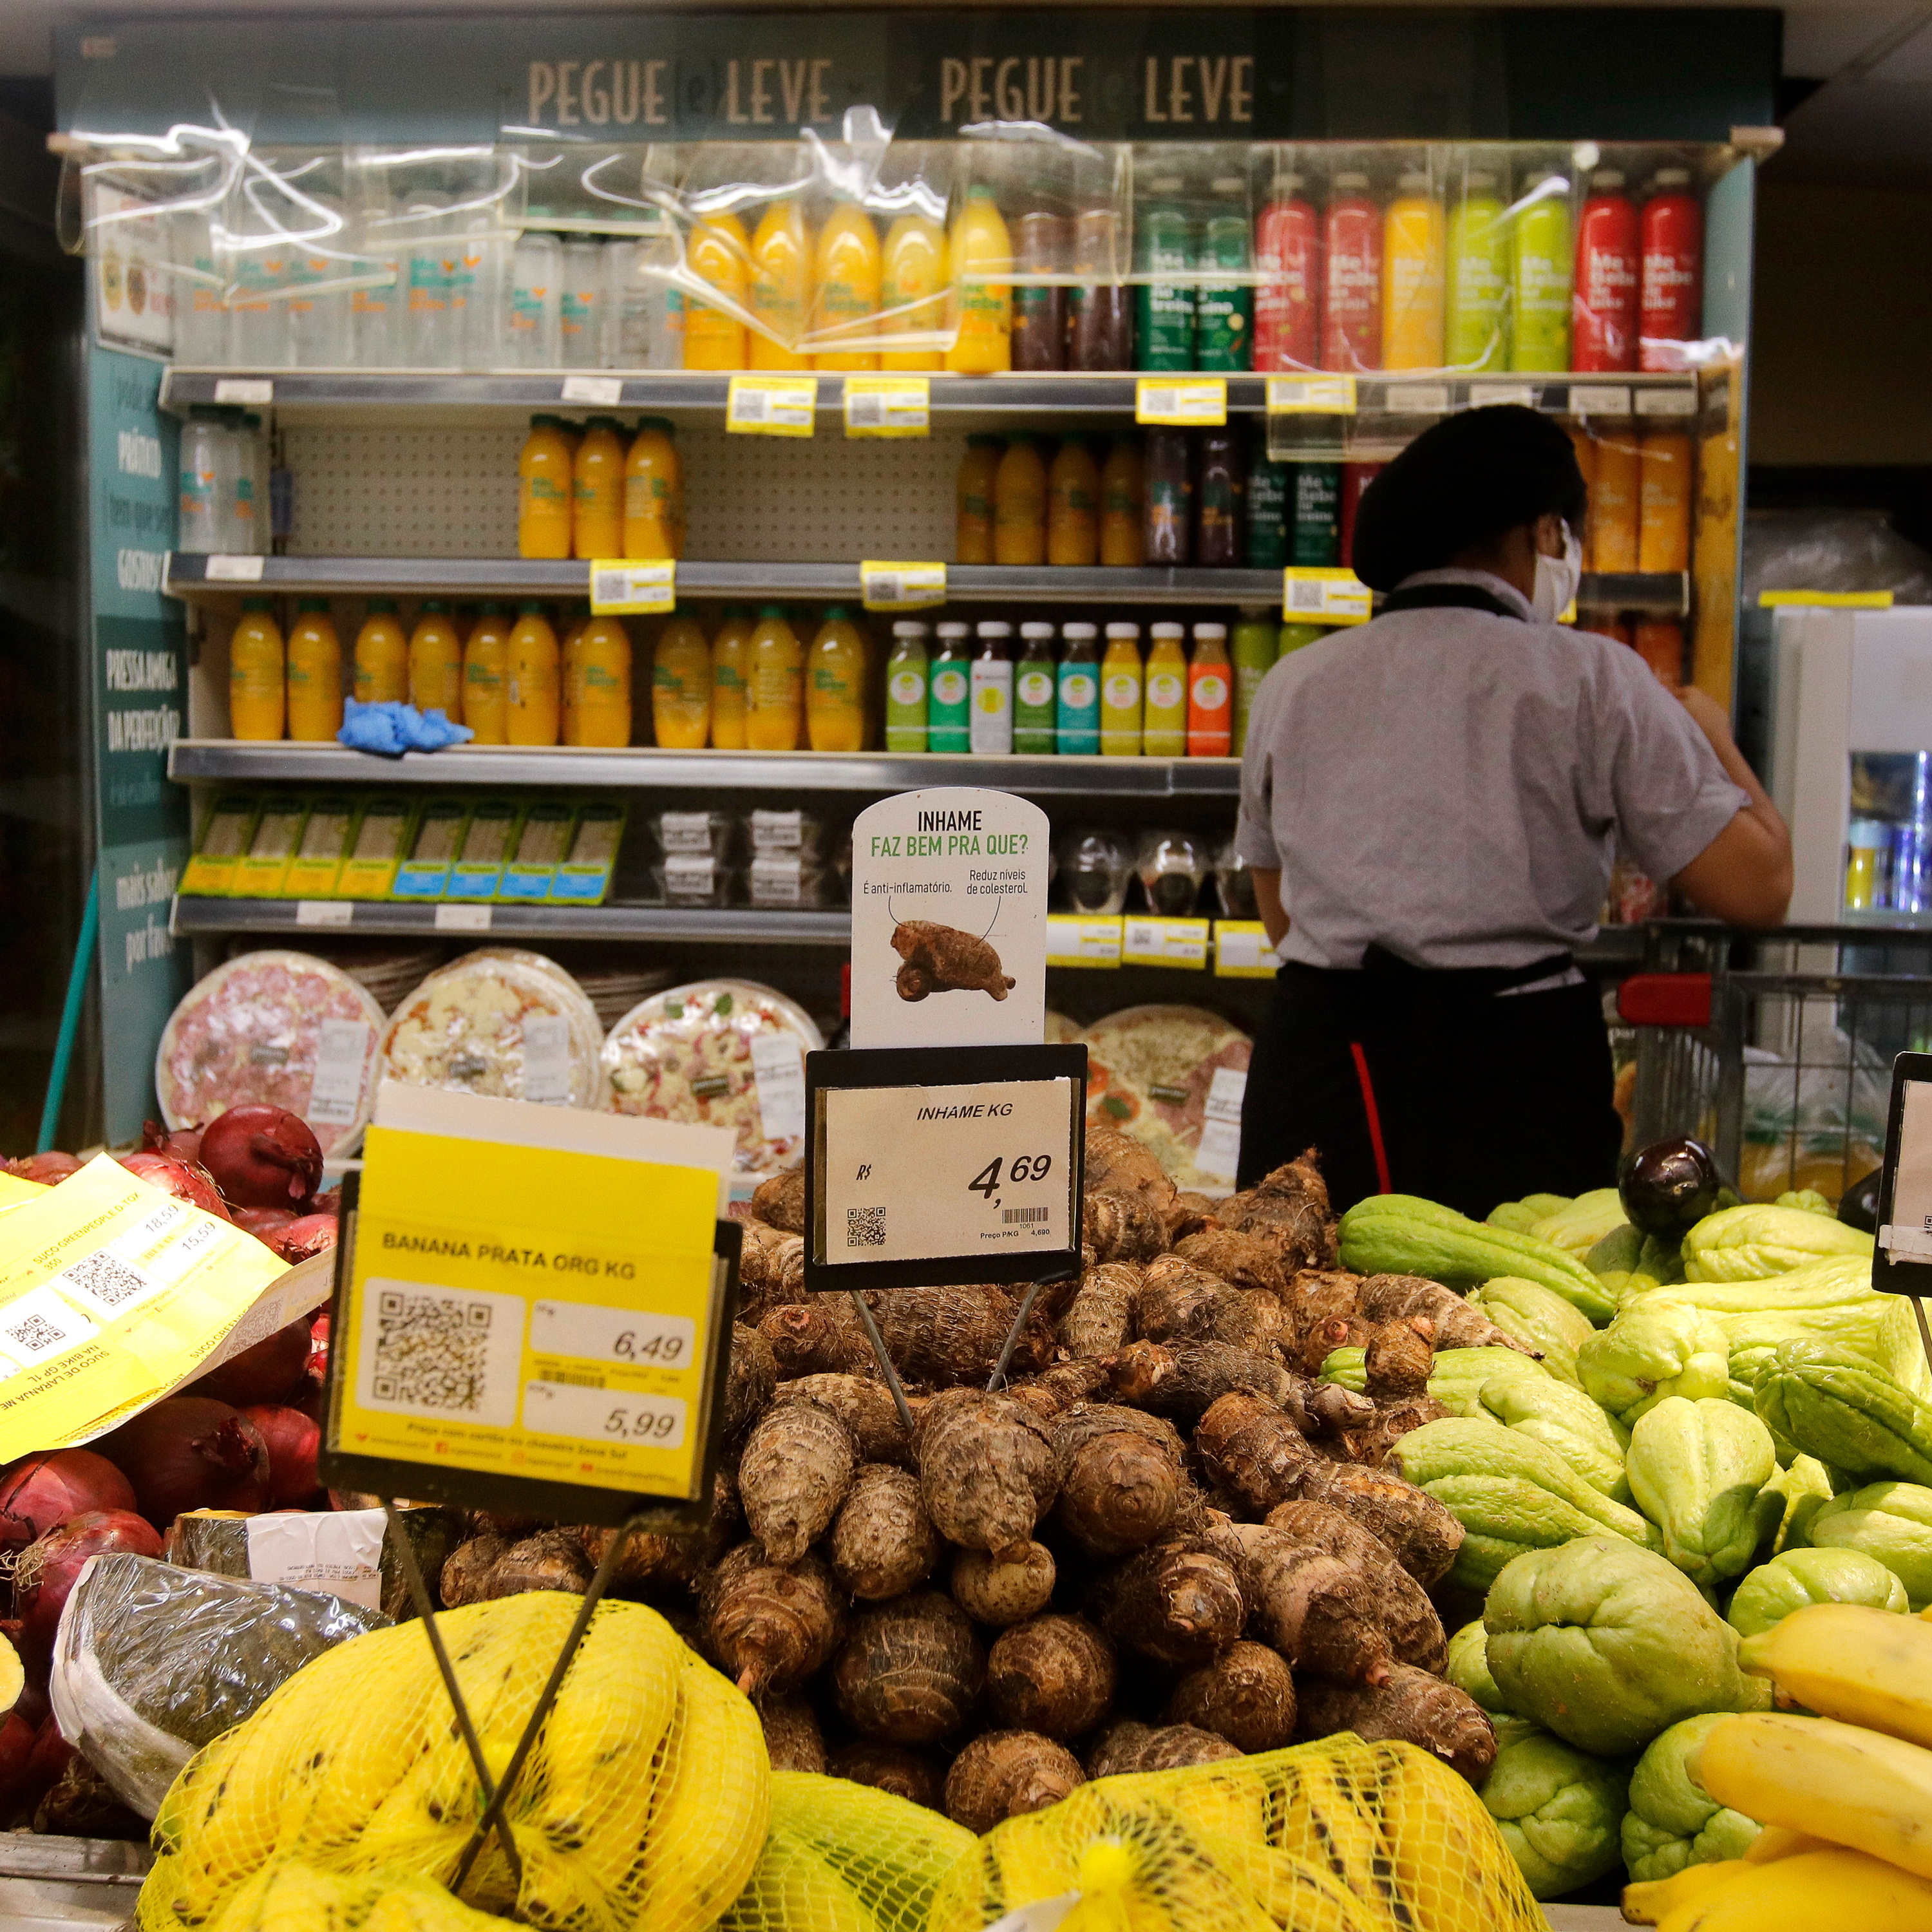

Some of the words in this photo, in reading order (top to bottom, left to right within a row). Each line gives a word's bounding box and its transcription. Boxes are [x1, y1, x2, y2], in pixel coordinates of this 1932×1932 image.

[528, 60, 667, 126] PEGUE
[726, 59, 833, 125] LEVE
[940, 56, 1083, 122] PEGUE
[1145, 55, 1254, 122] LEVE
[918, 811, 982, 831] INHAME
[871, 837, 900, 857] FAZ
[907, 835, 942, 856] BEM
[949, 835, 980, 855] PRA
[987, 835, 1028, 855] QUE?
[970, 869, 997, 881] Reduz
[999, 869, 1026, 880] níveis
[864, 880, 869, 893] É
[871, 881, 952, 893] anti-inflamatório.
[967, 883, 978, 894] de
[980, 882, 1028, 894] colesterol.
[917, 1104, 985, 1121] INHAME
[987, 1103, 1013, 1117] KG
[856, 1164, 872, 1180] R$
[968, 1155, 1052, 1209] 4,69
[146, 1204, 178, 1233] 18,59
[33, 1246, 59, 1264] SUCO
[58, 1209, 118, 1247] GREENPEOPLE
[115, 1192, 141, 1213] D-TOX
[182, 1221, 216, 1250] 15,59
[44, 1258, 62, 1271] 350
[382, 1231, 471, 1259] BANANA
[477, 1244, 547, 1269] PRATA
[553, 1254, 598, 1276] ORG
[604, 1261, 636, 1280] KG
[82, 1345, 100, 1354] NA
[190, 1340, 215, 1358] SUCO
[614, 1330, 683, 1361] 6,49
[57, 1353, 84, 1368] BIKE
[80, 1350, 109, 1368] SUCO
[27, 1374, 42, 1383] 1L
[44, 1367, 58, 1377] GP
[64, 1367, 80, 1378] DE
[15, 1376, 66, 1401] LARANJA
[604, 1408, 675, 1439] 5,99
